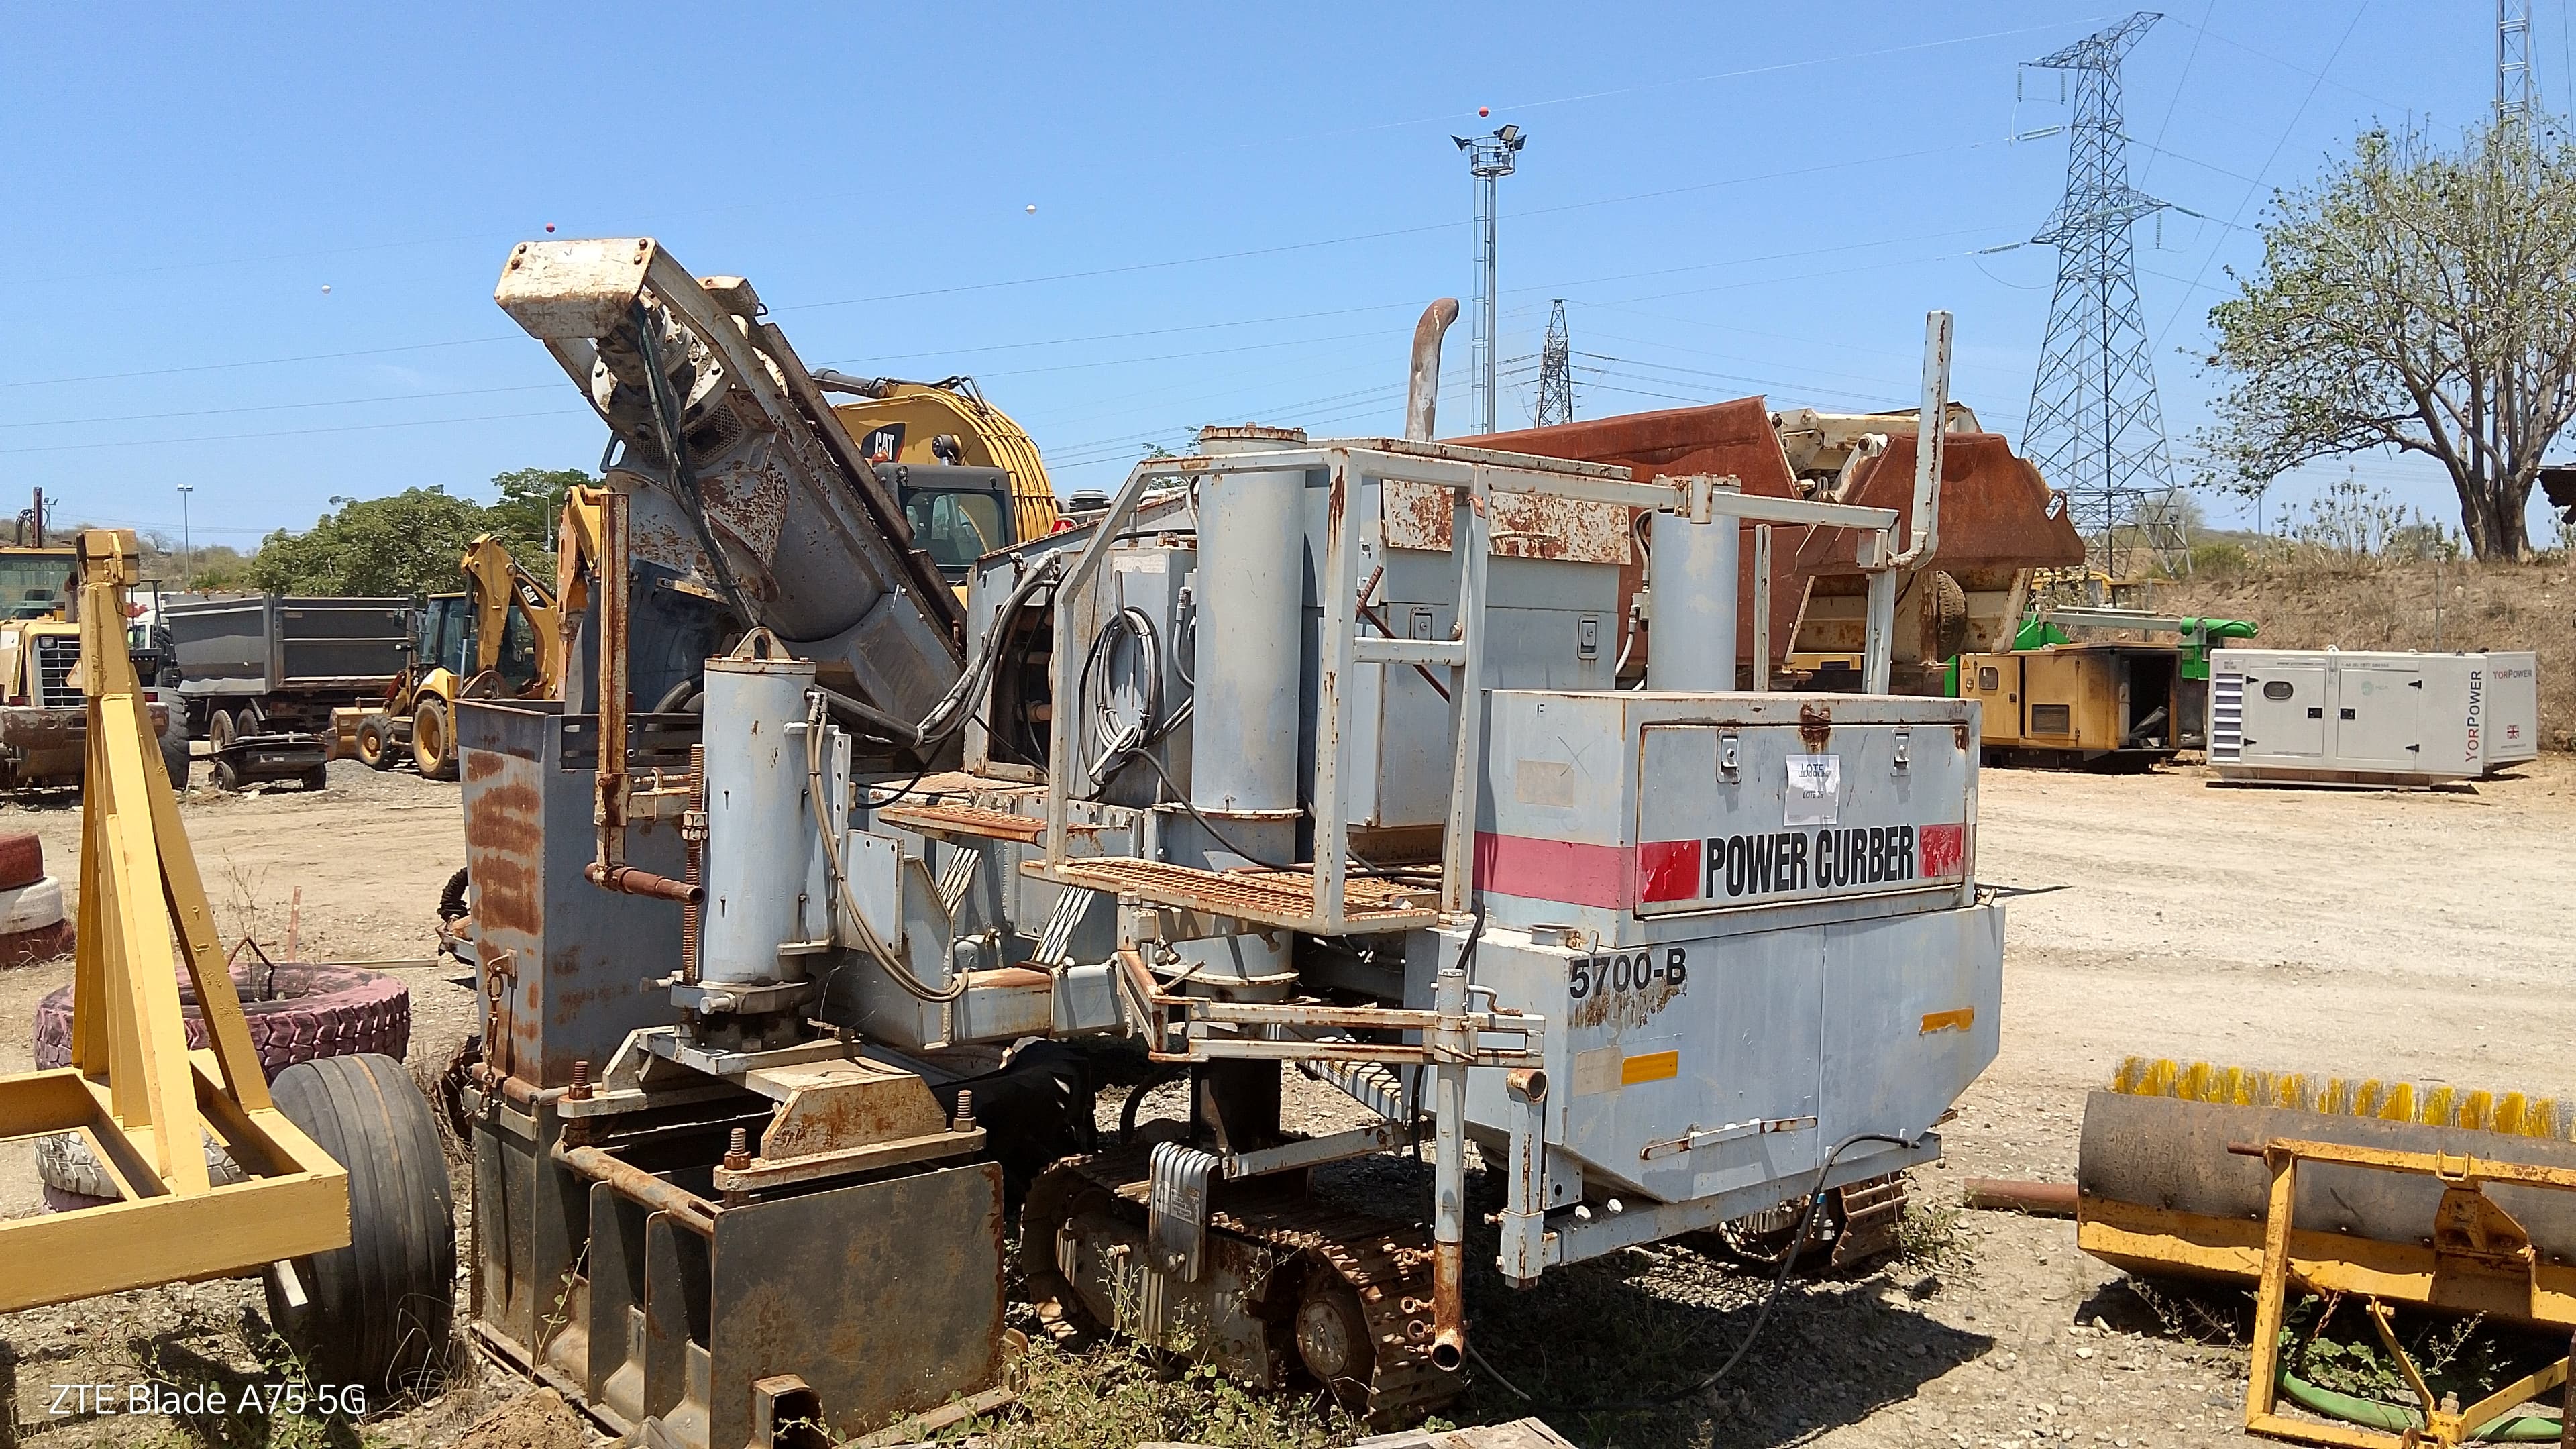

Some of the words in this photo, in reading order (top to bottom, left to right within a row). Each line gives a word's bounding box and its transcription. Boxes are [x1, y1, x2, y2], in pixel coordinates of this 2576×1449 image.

[875, 431, 894, 460] CAT
[521, 585, 539, 604] CAT
[1705, 832, 1807, 898] POWER
[1815, 824, 1914, 888] CURBER
[1570, 947, 1686, 999] 5700-B
